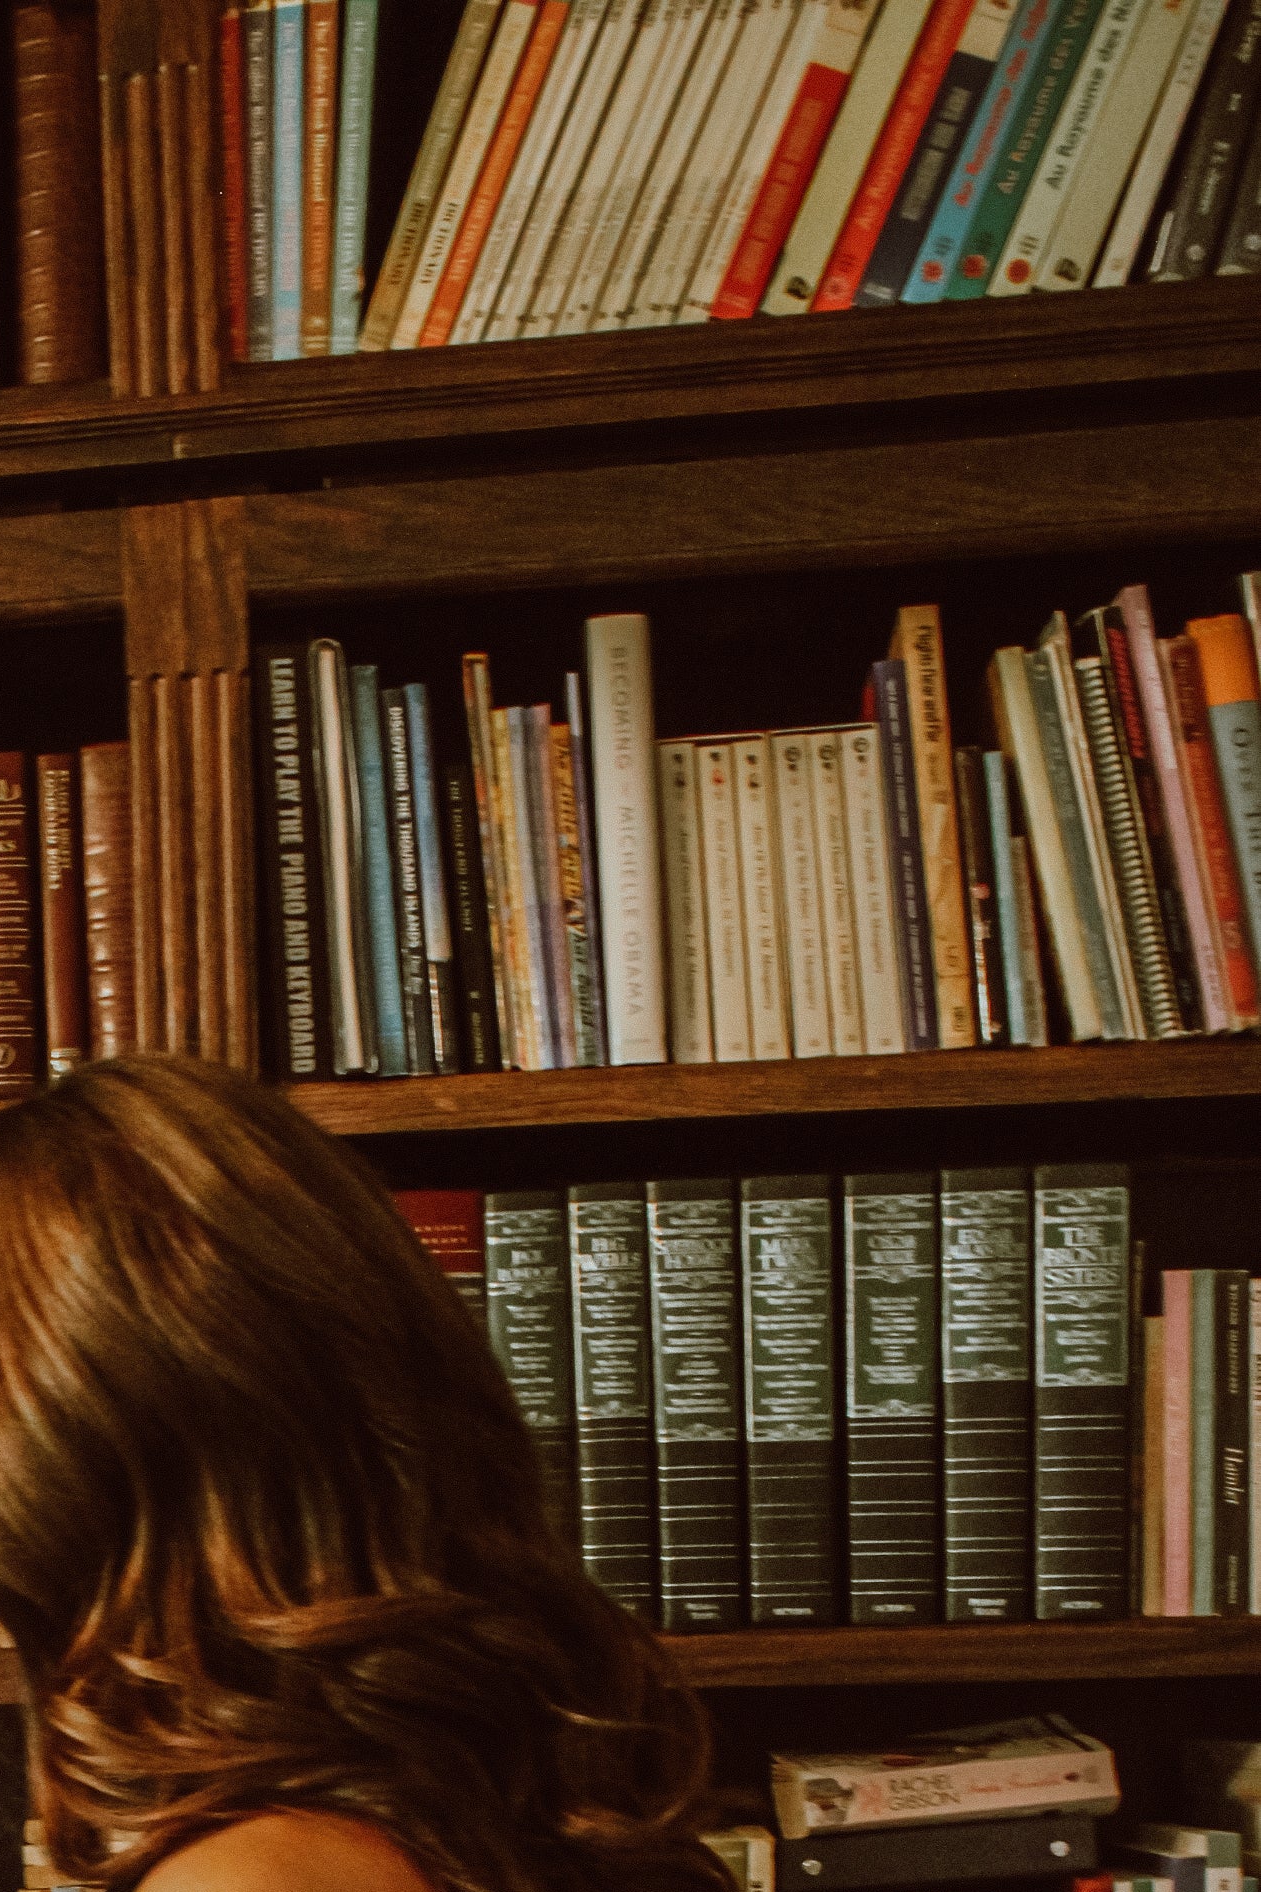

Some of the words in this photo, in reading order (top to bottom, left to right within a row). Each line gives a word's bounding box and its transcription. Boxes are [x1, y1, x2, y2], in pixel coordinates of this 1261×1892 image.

[1097, 28, 1121, 63] des
[1055, 68, 1106, 158] Royaume
[995, 171, 1017, 194] Au
[1046, 163, 1068, 190] Au
[387, 202, 425, 286] DICTIONARY
[419, 201, 458, 285] DICTIONARY
[270, 658, 297, 720] LEARN
[609, 646, 634, 771] BECOMING
[271, 725, 298, 753] TO
[388, 707, 409, 791] DISCOVERING
[273, 755, 302, 802] PLAY
[396, 795, 411, 818] THE
[278, 807, 304, 845] THE
[280, 853, 307, 915] PIANO
[397, 822, 417, 892] THOUSAND
[618, 806, 640, 919] MICHELLE
[284, 919, 310, 962] AND
[404, 894, 422, 949] ISLANDS
[623, 933, 644, 1019] OBAMA
[286, 966, 316, 1073] KEYBOARD
[1058, 1227, 1103, 1247] THE
[1223, 1447, 1244, 1504] Hamlet
